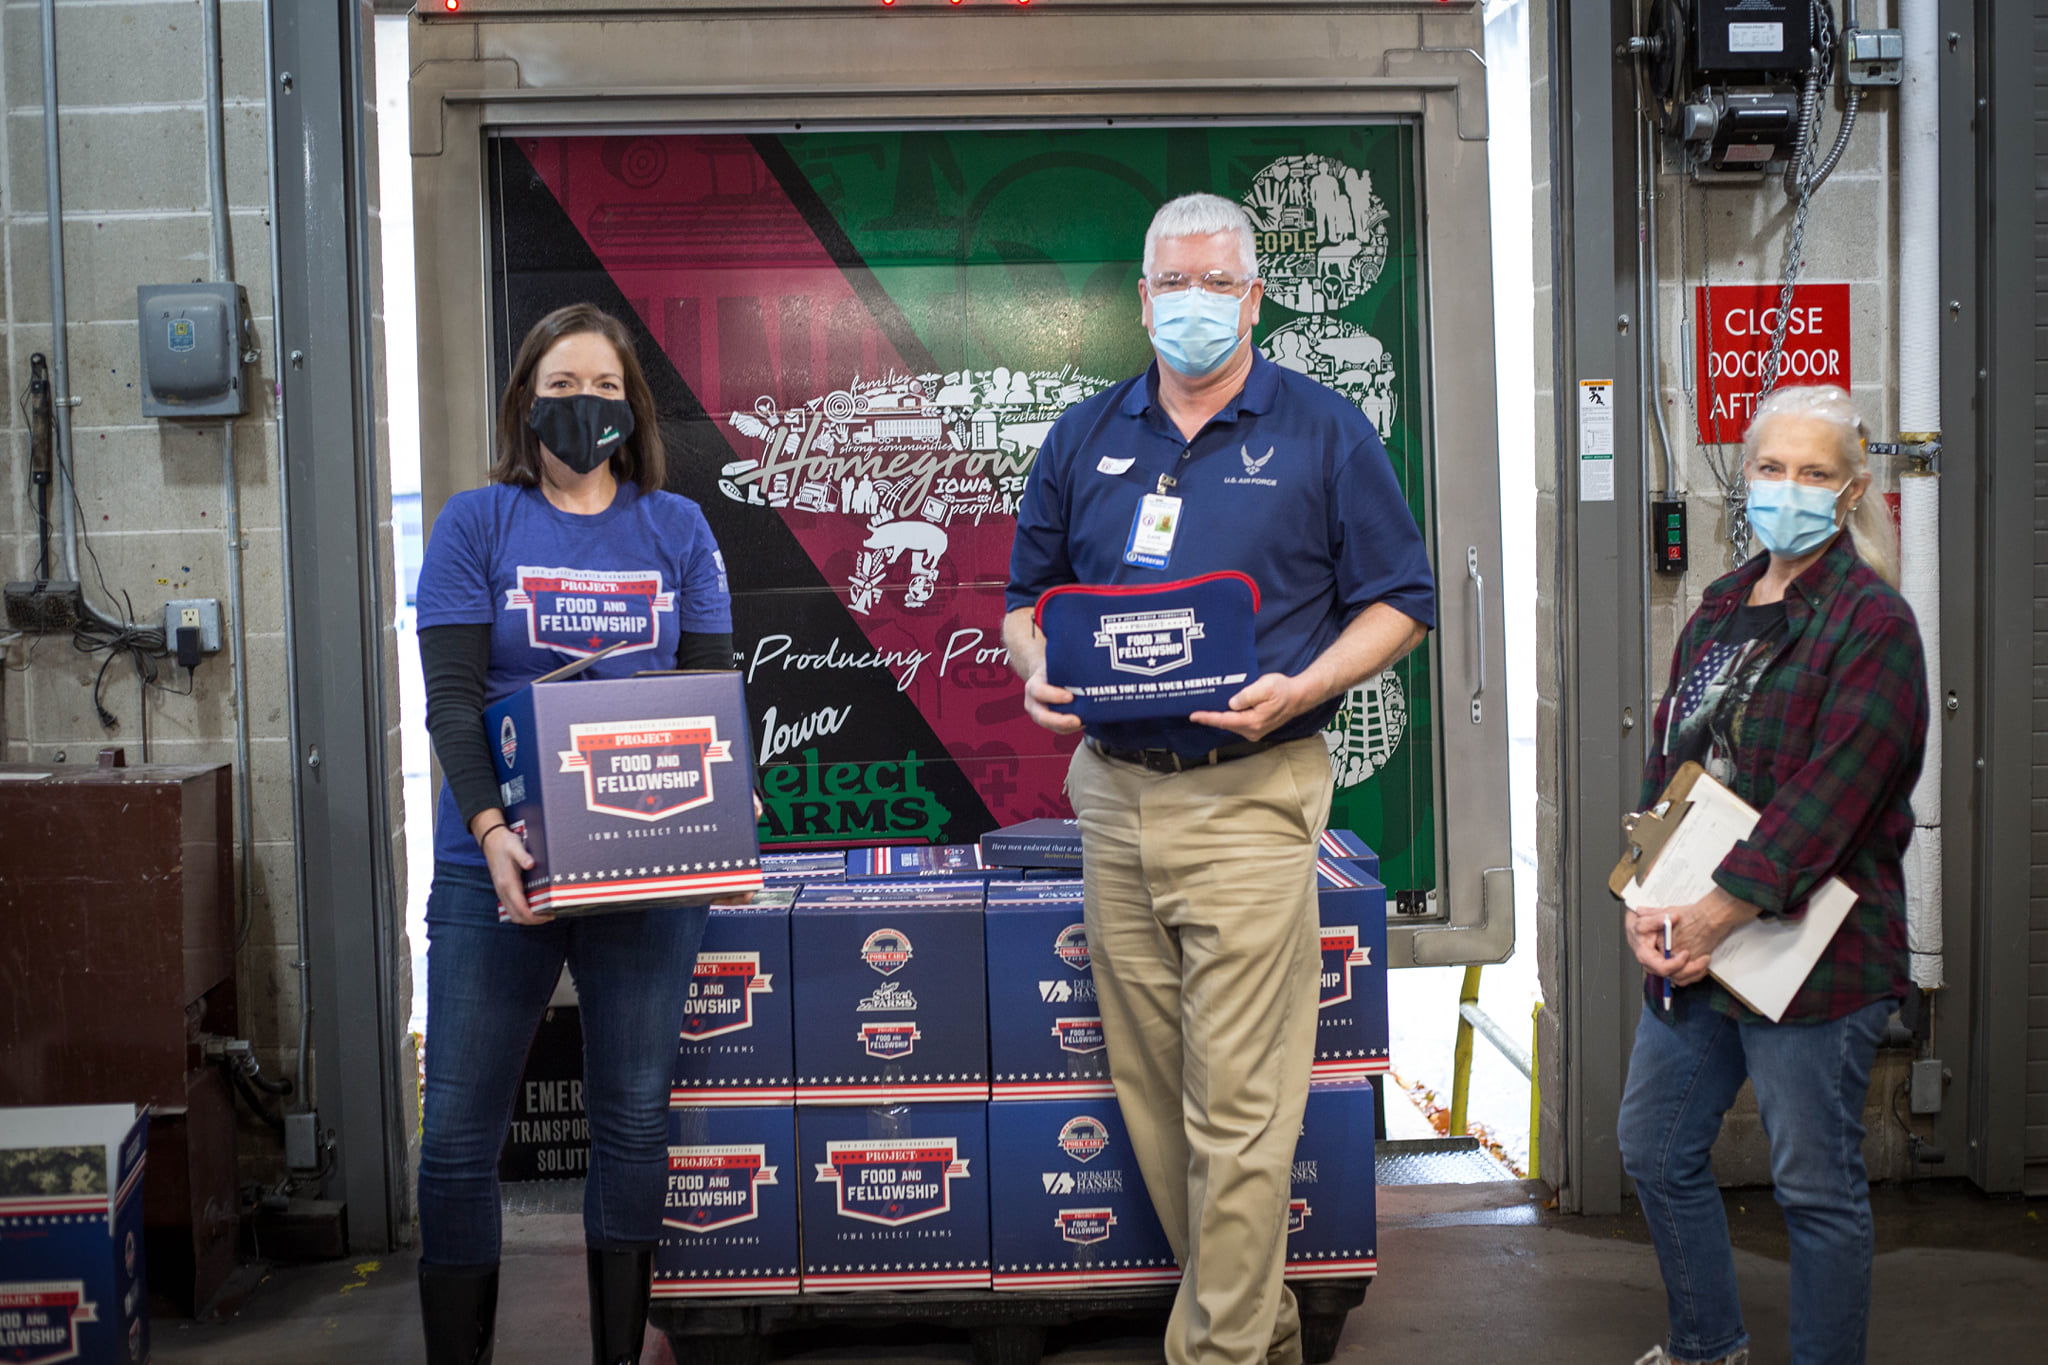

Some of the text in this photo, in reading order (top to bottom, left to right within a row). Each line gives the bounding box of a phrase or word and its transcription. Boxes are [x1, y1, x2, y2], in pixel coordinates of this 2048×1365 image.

[1254, 231, 1317, 253] EOPLE
[1258, 252, 1304, 269] are
[1725, 307, 1822, 335] CLOSE
[1708, 348, 1840, 378] DOCK DOOR
[851, 368, 916, 398] families
[1029, 363, 1116, 388] small busine
[1710, 392, 1755, 420] AFT
[839, 437, 955, 461] strong communities
[734, 412, 1041, 519] Homegrow
[934, 476, 1029, 494] IOWA SEL
[1224, 477, 1237, 485] U.S.
[1251, 478, 1278, 487] FORCE
[945, 491, 1004, 528] people
[1138, 555, 1165, 566] Veteran
[555, 597, 627, 614] FOOD AND
[540, 615, 648, 633] FELLOWSHIP
[1127, 634, 1153, 647] FOOD
[1118, 643, 1183, 659] FELLOWSHIP
[748, 634, 932, 691] Producing
[1085, 676, 1222, 696] THANK YOU FOR YOUR SERVICE
[760, 704, 852, 766] Iowa
[610, 754, 680, 774] FOOD AND
[597, 770, 701, 794] FELLOWSHIP
[763, 747, 925, 800] elect
[758, 796, 930, 839] ARMS
[589, 824, 718, 841] IOWA SELECT FARMS
[1052, 844, 1066, 852] that
[693, 964, 720, 975] JECT:
[704, 984, 724, 996] AND
[1073, 988, 1098, 999] HAN
[684, 998, 742, 1014] OWSHIP
[1064, 1034, 1103, 1044] FELLOWSHIP
[1070, 1029, 1085, 1037] FOOD
[680, 1045, 754, 1055] ELECT FARMS
[870, 1041, 909, 1049] FELLOWSHIP
[526, 1080, 585, 1113] EMER
[511, 1118, 591, 1144] TRANSPOR
[1066, 1140, 1084, 1148] PORK
[537, 1147, 590, 1172] SOLUTI
[668, 1174, 730, 1190] FOOD AND
[861, 1168, 922, 1185] FOOD AND
[1291, 1168, 1317, 1179] NSEN
[847, 1183, 939, 1201] FELLOWSHIP
[1077, 1178, 1122, 1190] HANSEN
[664, 1190, 747, 1207] ELLOWSHIP
[1067, 1226, 1105, 1235] FELLOWSHIP
[1073, 1220, 1088, 1228] FOOD
[659, 1236, 760, 1246] WA SELECT FARMS
[837, 1229, 952, 1241] IOWA SELECT FARMS
[26, 1313, 48, 1326] AND
[0, 1326, 66, 1346] LOWSHIP
